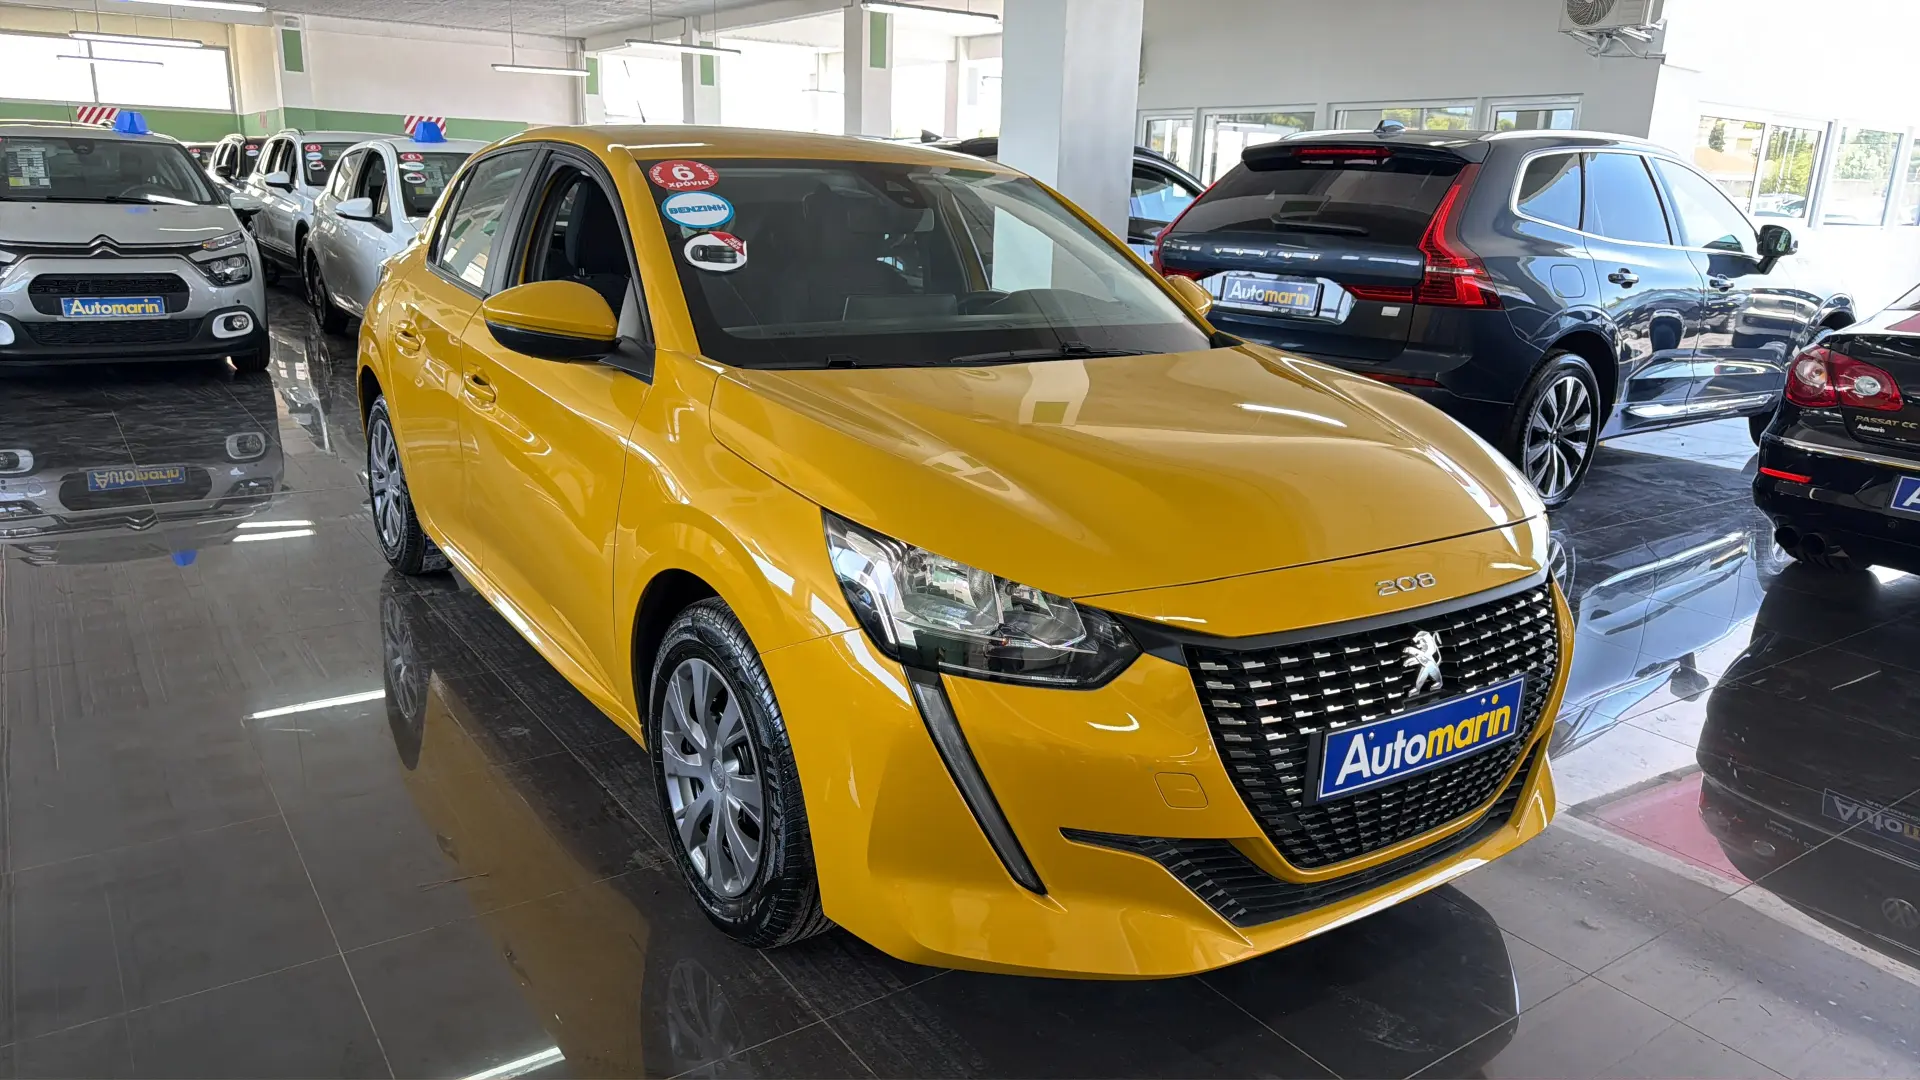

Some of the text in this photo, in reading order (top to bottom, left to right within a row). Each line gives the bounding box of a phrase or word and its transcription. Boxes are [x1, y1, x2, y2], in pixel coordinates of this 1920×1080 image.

[672, 166, 695, 180] 6
[668, 180, 710, 188] χρόνια
[668, 204, 727, 214] ΒΕΝΖΙΝΗ
[1229, 280, 1309, 305] Automarin
[70, 299, 159, 315] Automarin
[1855, 415, 1918, 429] PASSAT CC
[1857, 424, 1885, 433] Automarin
[1376, 572, 1436, 596] 208
[1335, 694, 1511, 786] Automarin
